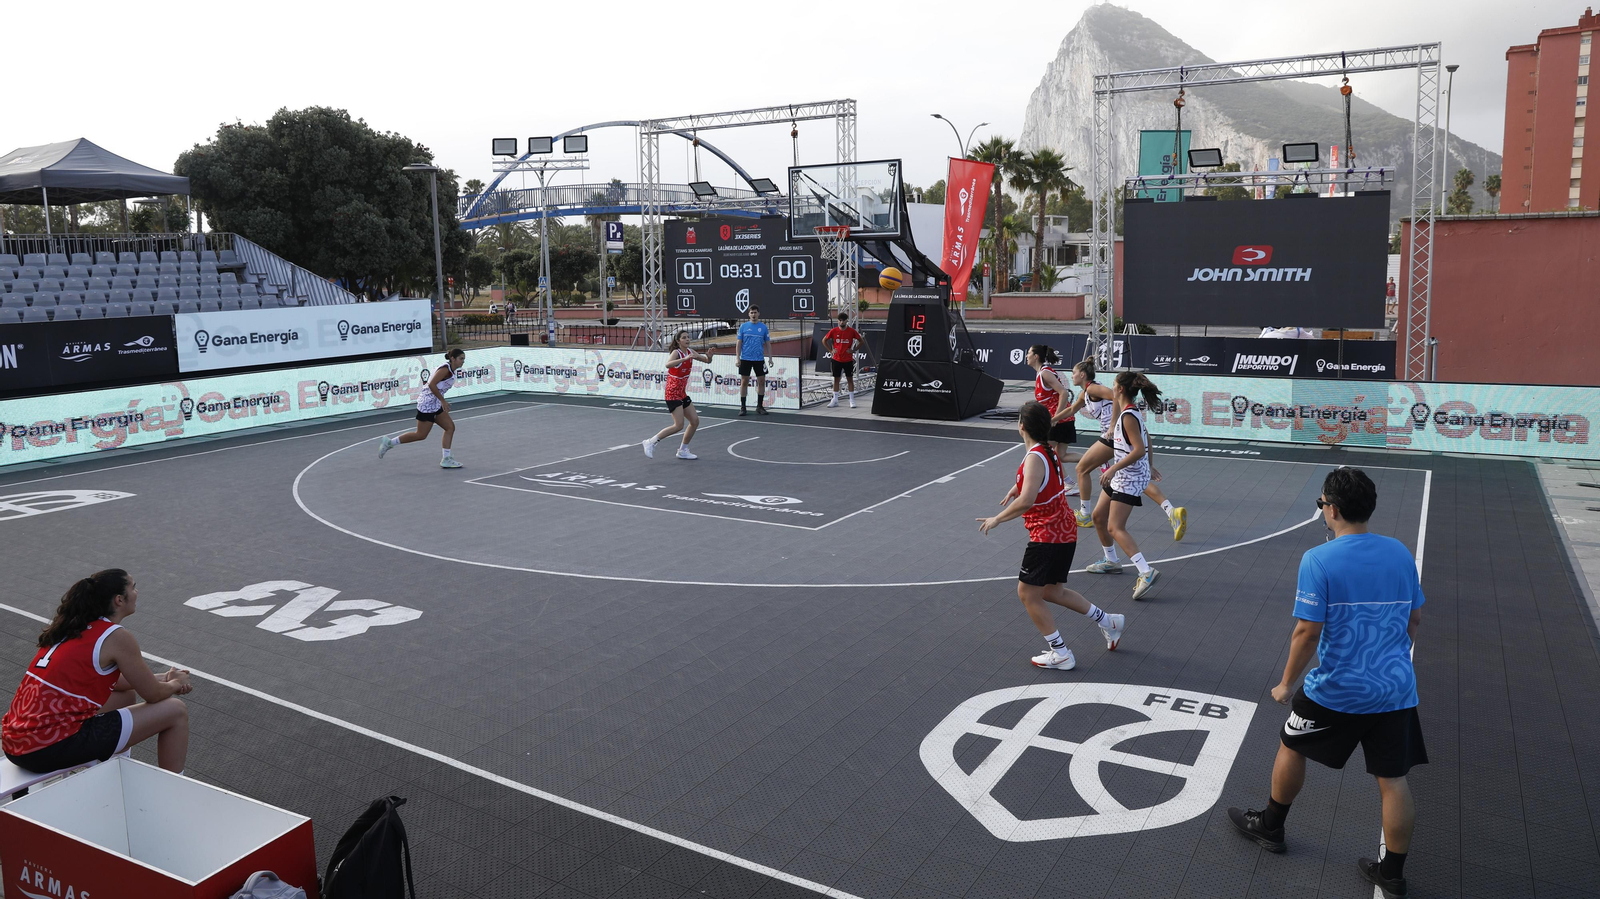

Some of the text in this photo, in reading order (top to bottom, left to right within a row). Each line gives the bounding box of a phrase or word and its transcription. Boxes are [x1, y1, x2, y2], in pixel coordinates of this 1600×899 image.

[1157, 155, 1172, 201] Enegía
[609, 223, 617, 239] P
[951, 226, 965, 266] ARMAS
[683, 262, 705, 280] 01
[720, 263, 762, 278] 09:31
[778, 260, 806, 279] 00
[1187, 267, 1312, 282] JOHN SMITH
[683, 297, 690, 307] 0
[800, 298, 807, 309] 0
[351, 319, 422, 336] Gana Energía
[912, 315, 926, 330] 12
[212, 329, 299, 347] Gana Energía
[62, 342, 111, 354] ARMAS
[0, 344, 18, 370] N
[1239, 354, 1292, 366] MUNDO
[523, 365, 545, 376] Gana
[607, 368, 631, 380] Gana
[1350, 363, 1386, 373] Energía
[715, 374, 741, 387] Gana
[331, 385, 359, 396] Gana
[196, 402, 231, 414] Gana
[1251, 402, 1368, 424] Gana Energía
[1433, 411, 1485, 427] Gana
[11, 422, 66, 438] Gana
[535, 472, 667, 491] ARMAS
[1142, 692, 1230, 719] FEB
[1287, 710, 1316, 730] NIKE
[23, 859, 53, 875] NAVIERA
